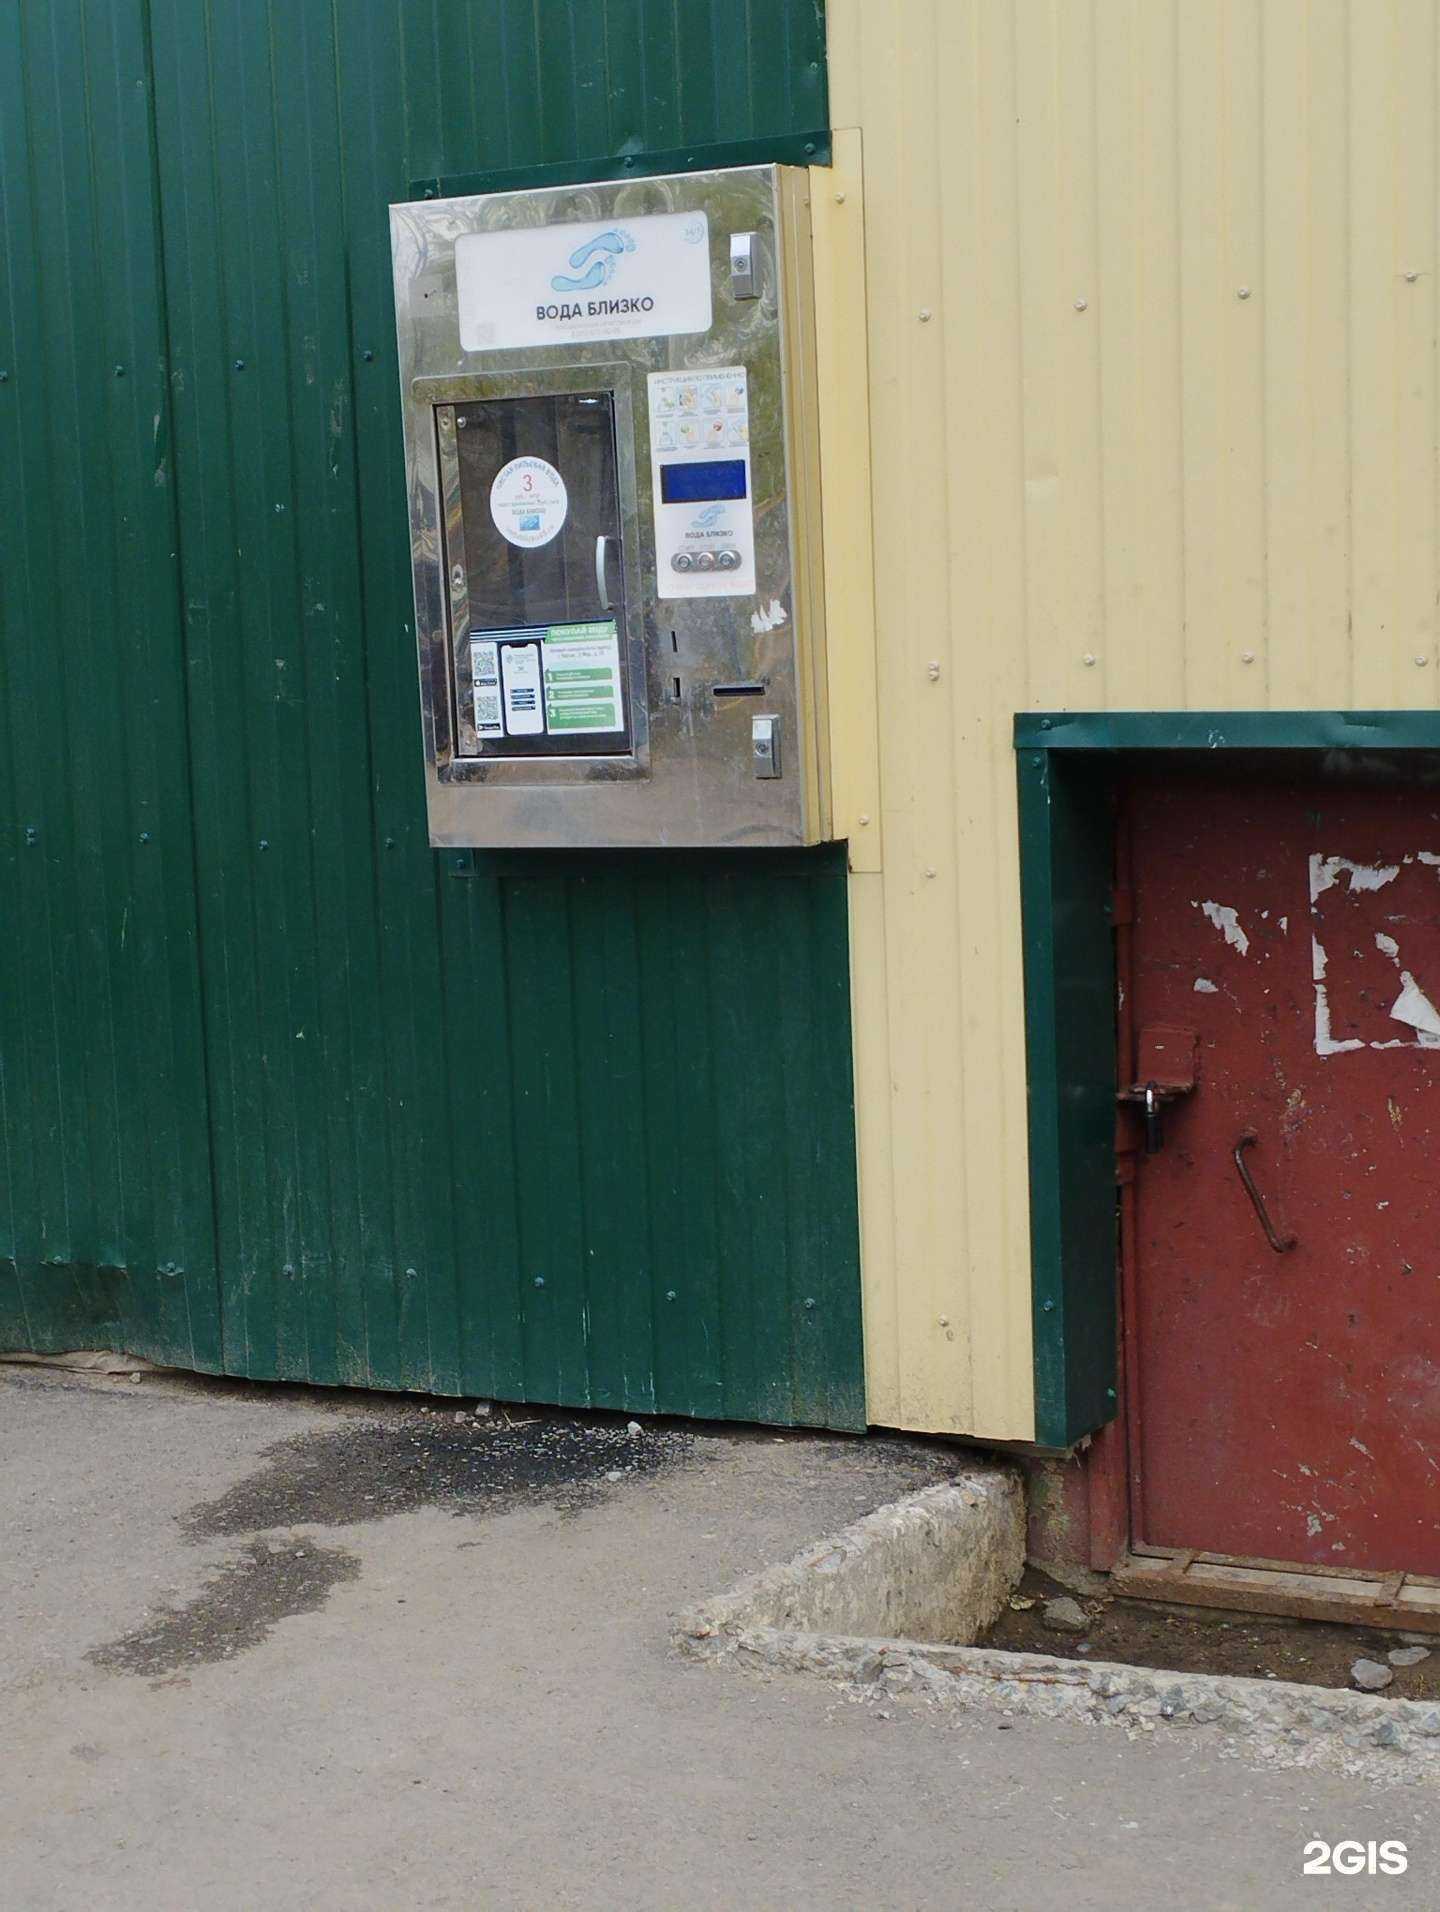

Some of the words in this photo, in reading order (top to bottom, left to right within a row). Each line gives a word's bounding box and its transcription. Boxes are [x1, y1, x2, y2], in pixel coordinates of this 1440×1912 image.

[536, 304, 582, 321] ВОДА
[588, 297, 654, 315] БЛИЗКО
[523, 474, 533, 492] 3
[685, 531, 704, 539] ВОДА
